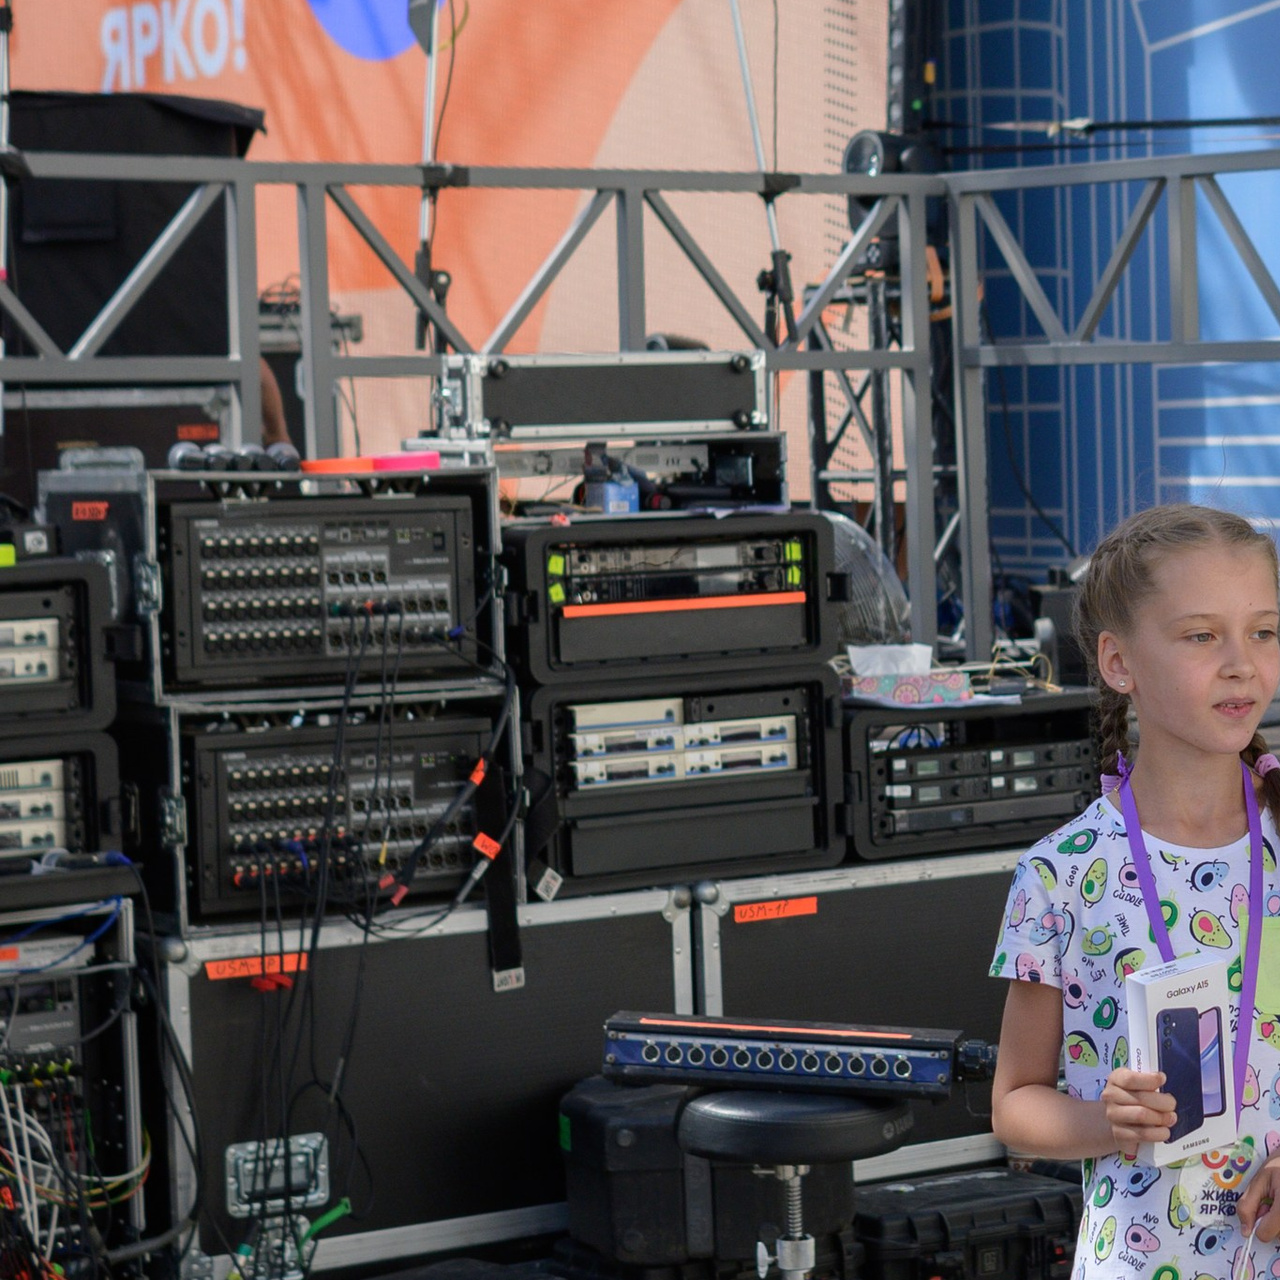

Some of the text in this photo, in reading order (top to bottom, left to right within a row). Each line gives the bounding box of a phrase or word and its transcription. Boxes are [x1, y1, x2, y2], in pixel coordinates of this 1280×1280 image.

[1065, 864, 1080, 888] GOOD
[1112, 889, 1145, 908] CUDDLE
[1114, 913, 1131, 937] TIME!
[215, 957, 277, 976] USM-P
[1166, 980, 1209, 999] Galaxy A15
[1182, 1137, 1210, 1151] SAMSUNG
[1142, 1212, 1159, 1224] AVO
[1118, 1250, 1147, 1272] CUDDLE
